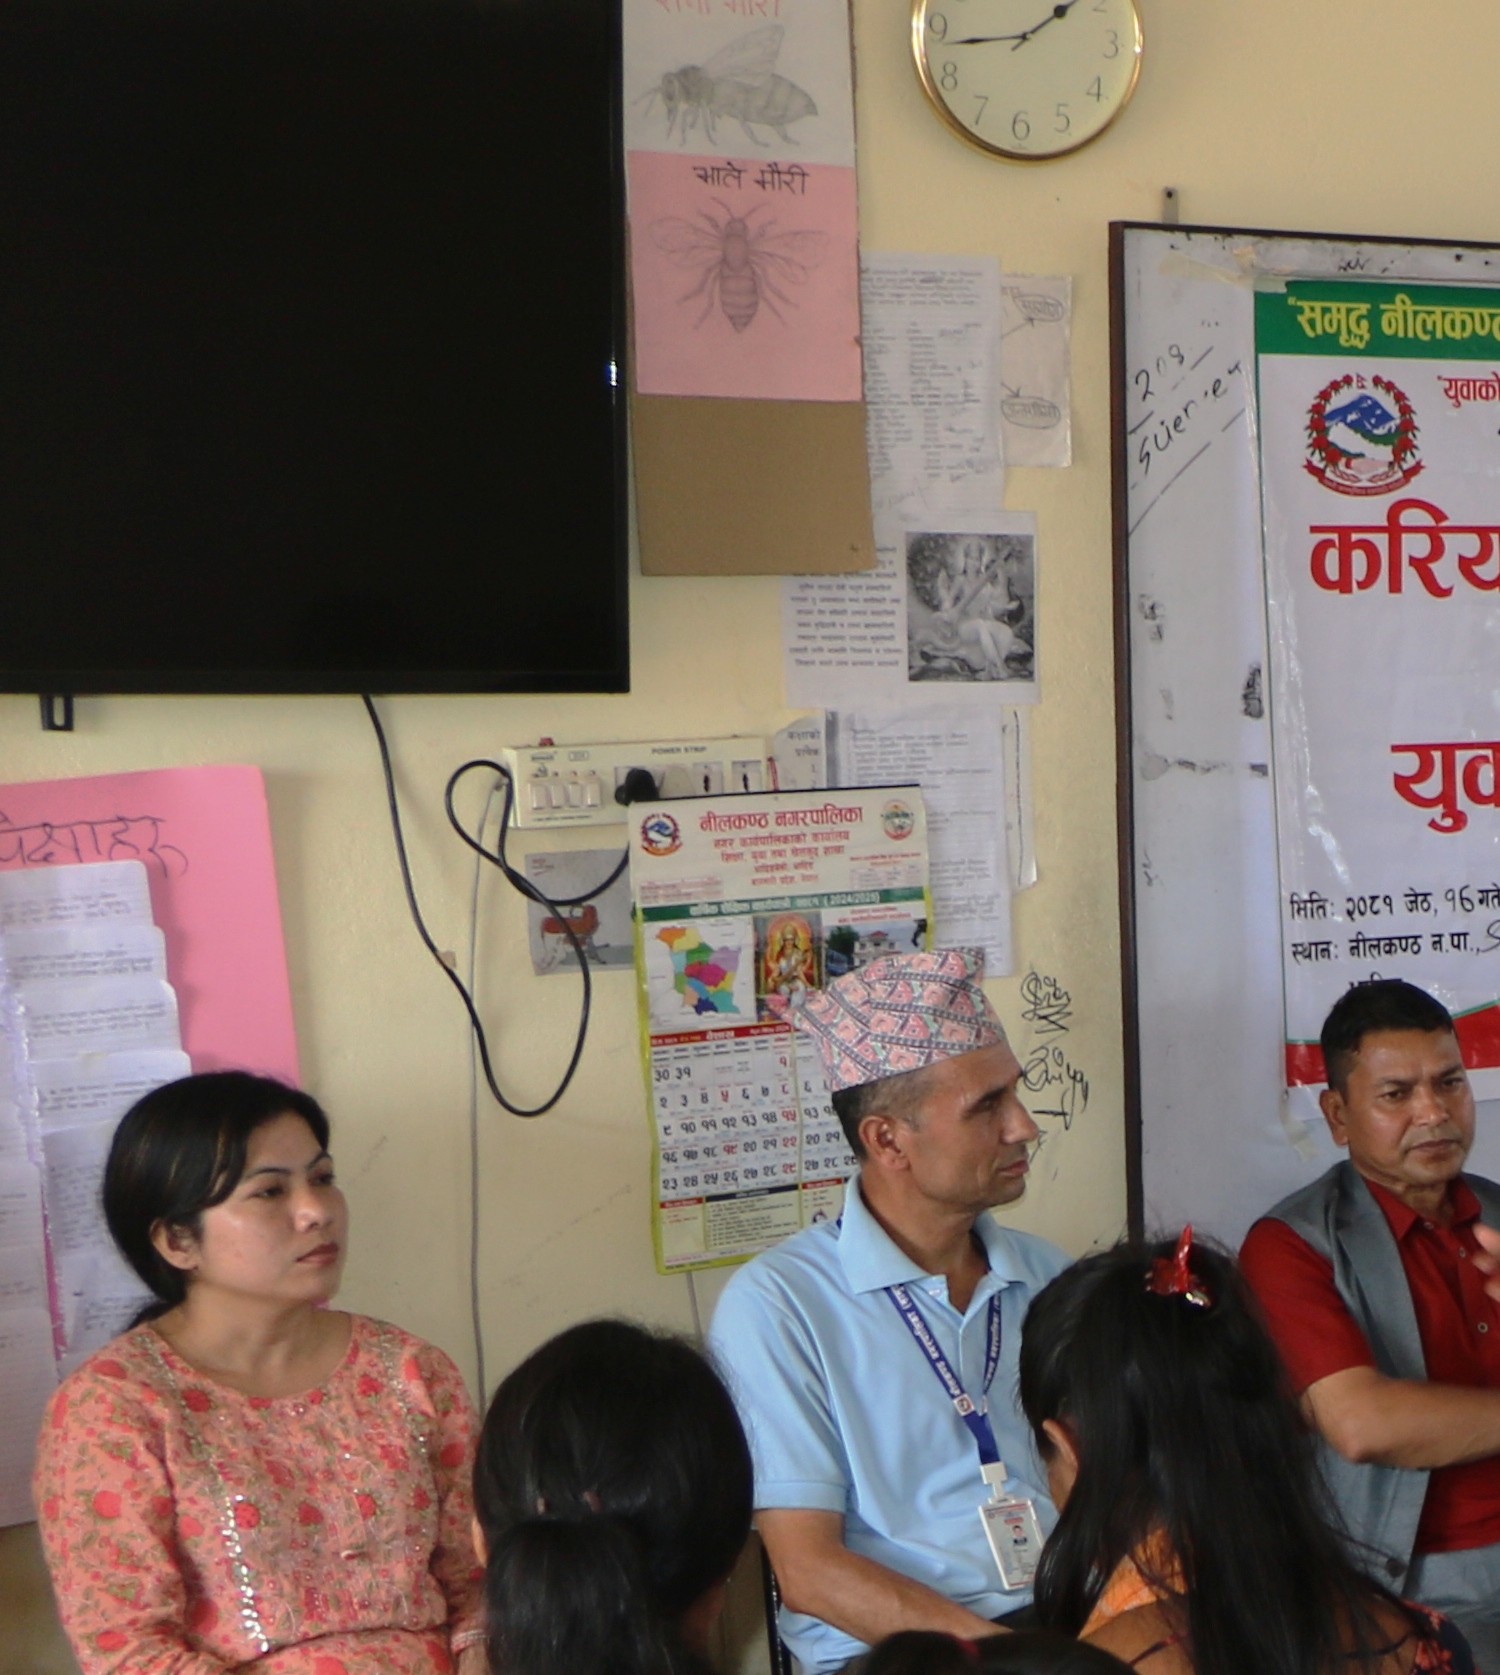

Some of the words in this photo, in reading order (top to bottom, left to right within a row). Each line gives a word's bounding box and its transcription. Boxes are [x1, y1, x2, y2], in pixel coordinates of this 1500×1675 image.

[928, 13, 948, 42] 9
[1103, 30, 1121, 59] 3
[941, 63, 959, 92] 8
[1086, 75, 1103, 103] 4
[973, 96, 989, 126] 7
[1011, 110, 1030, 140] 6
[1054, 104, 1071, 132] 5
[692, 161, 748, 189] भाले
[753, 161, 811, 195] मौरी
[699, 811, 769, 832] नीलकण्ठ
[775, 803, 864, 828] नगरपालिका
[1345, 894, 1394, 922] २०८१
[1403, 887, 1439, 917] जेठ,
[1348, 931, 1423, 960] नीलकण्ठ
